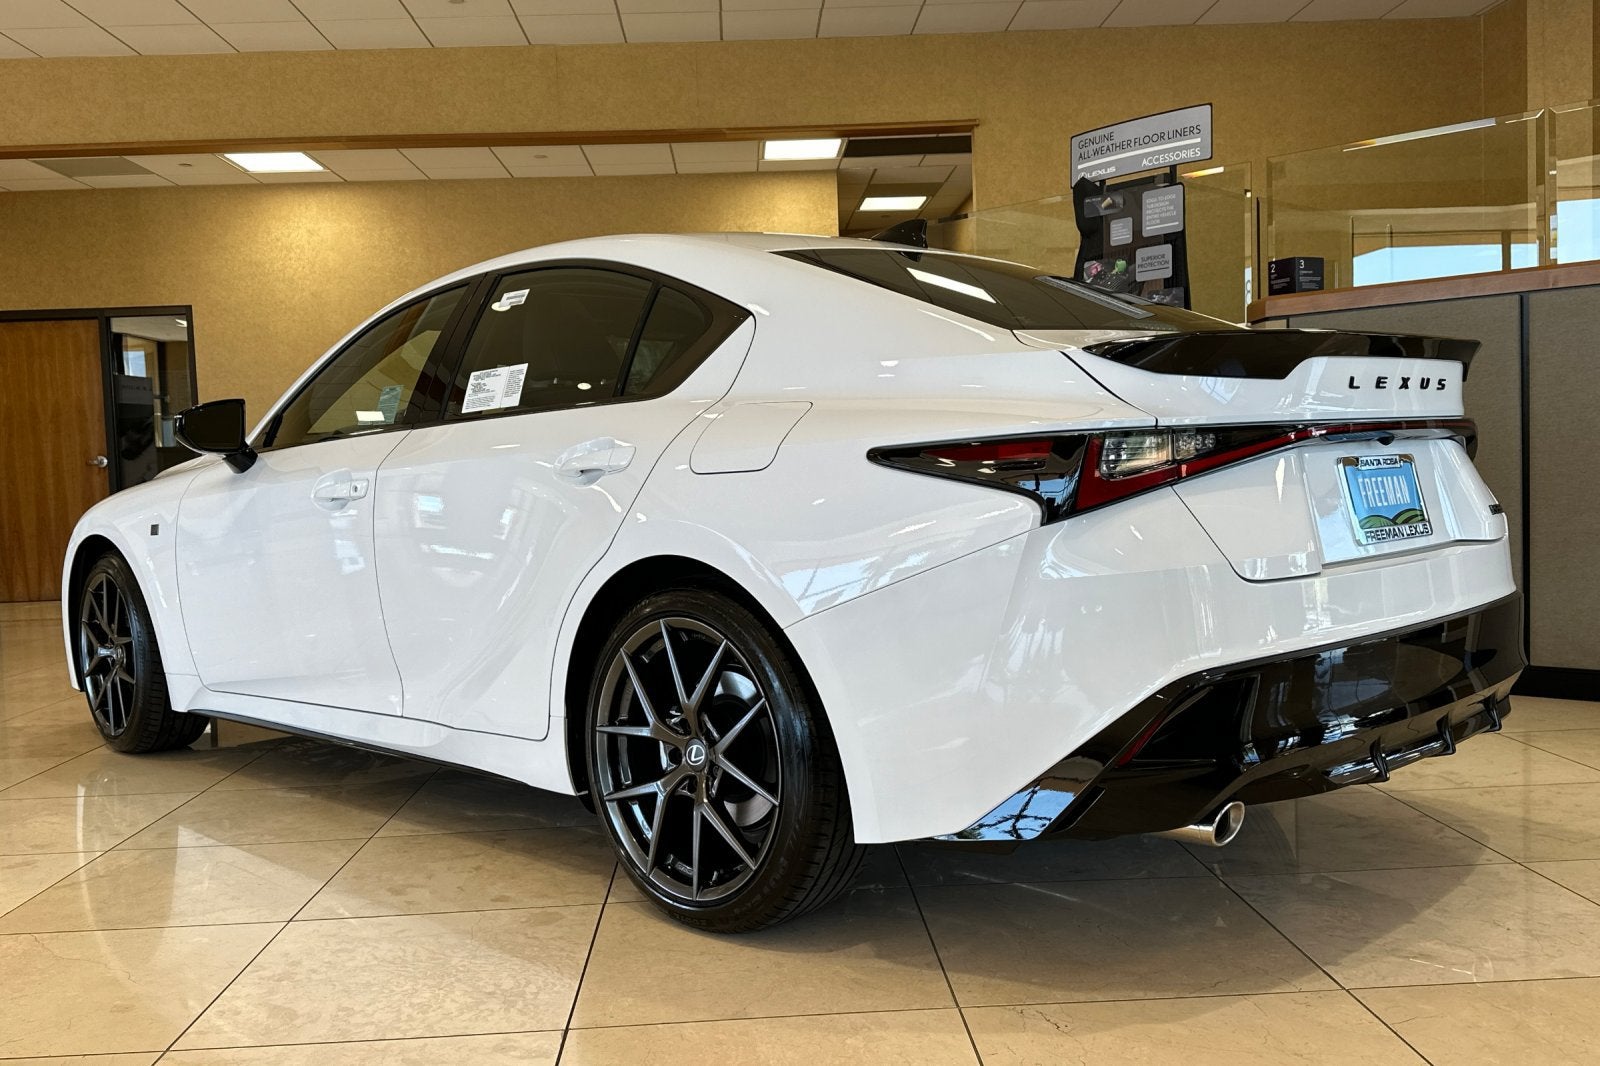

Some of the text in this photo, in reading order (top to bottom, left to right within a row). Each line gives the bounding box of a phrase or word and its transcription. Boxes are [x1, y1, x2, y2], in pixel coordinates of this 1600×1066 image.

[1078, 131, 1115, 150] GENUINE
[1078, 124, 1202, 161] ALL-WEATHER FLOOR LINERS
[1141, 147, 1201, 167] ACCESSORIES
[1087, 166, 1116, 178] LEXUS
[1140, 253, 1166, 261] SUPERIOR
[1299, 259, 1305, 269] 3
[1137, 260, 1170, 269] PROTECTION
[1270, 263, 1276, 273] 2
[1348, 375, 1447, 391] LEXUS
[1360, 458, 1398, 468] SANTA ROSA
[1357, 475, 1411, 509] FREEMAN
[1364, 523, 1430, 542] FREEMAN LEXUS
